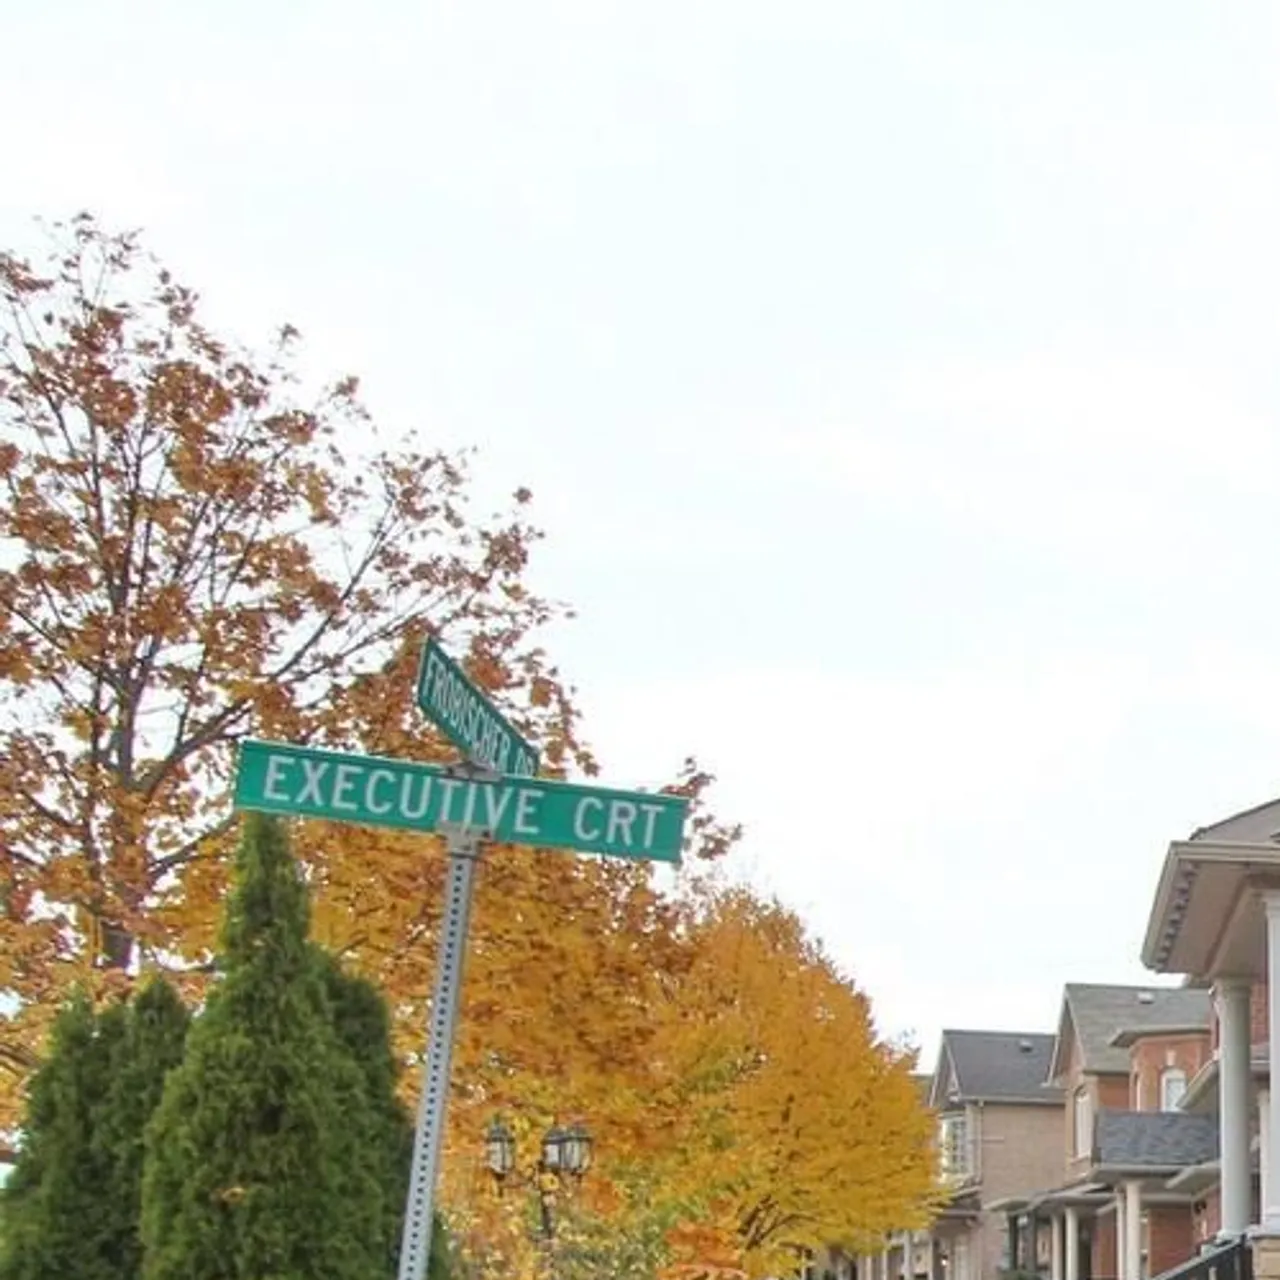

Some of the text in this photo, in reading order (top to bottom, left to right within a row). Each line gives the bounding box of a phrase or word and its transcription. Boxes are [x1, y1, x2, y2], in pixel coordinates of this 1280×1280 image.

[422, 650, 511, 773] FROBISCHER
[262, 754, 666, 849] EXECUTIVE CRT
